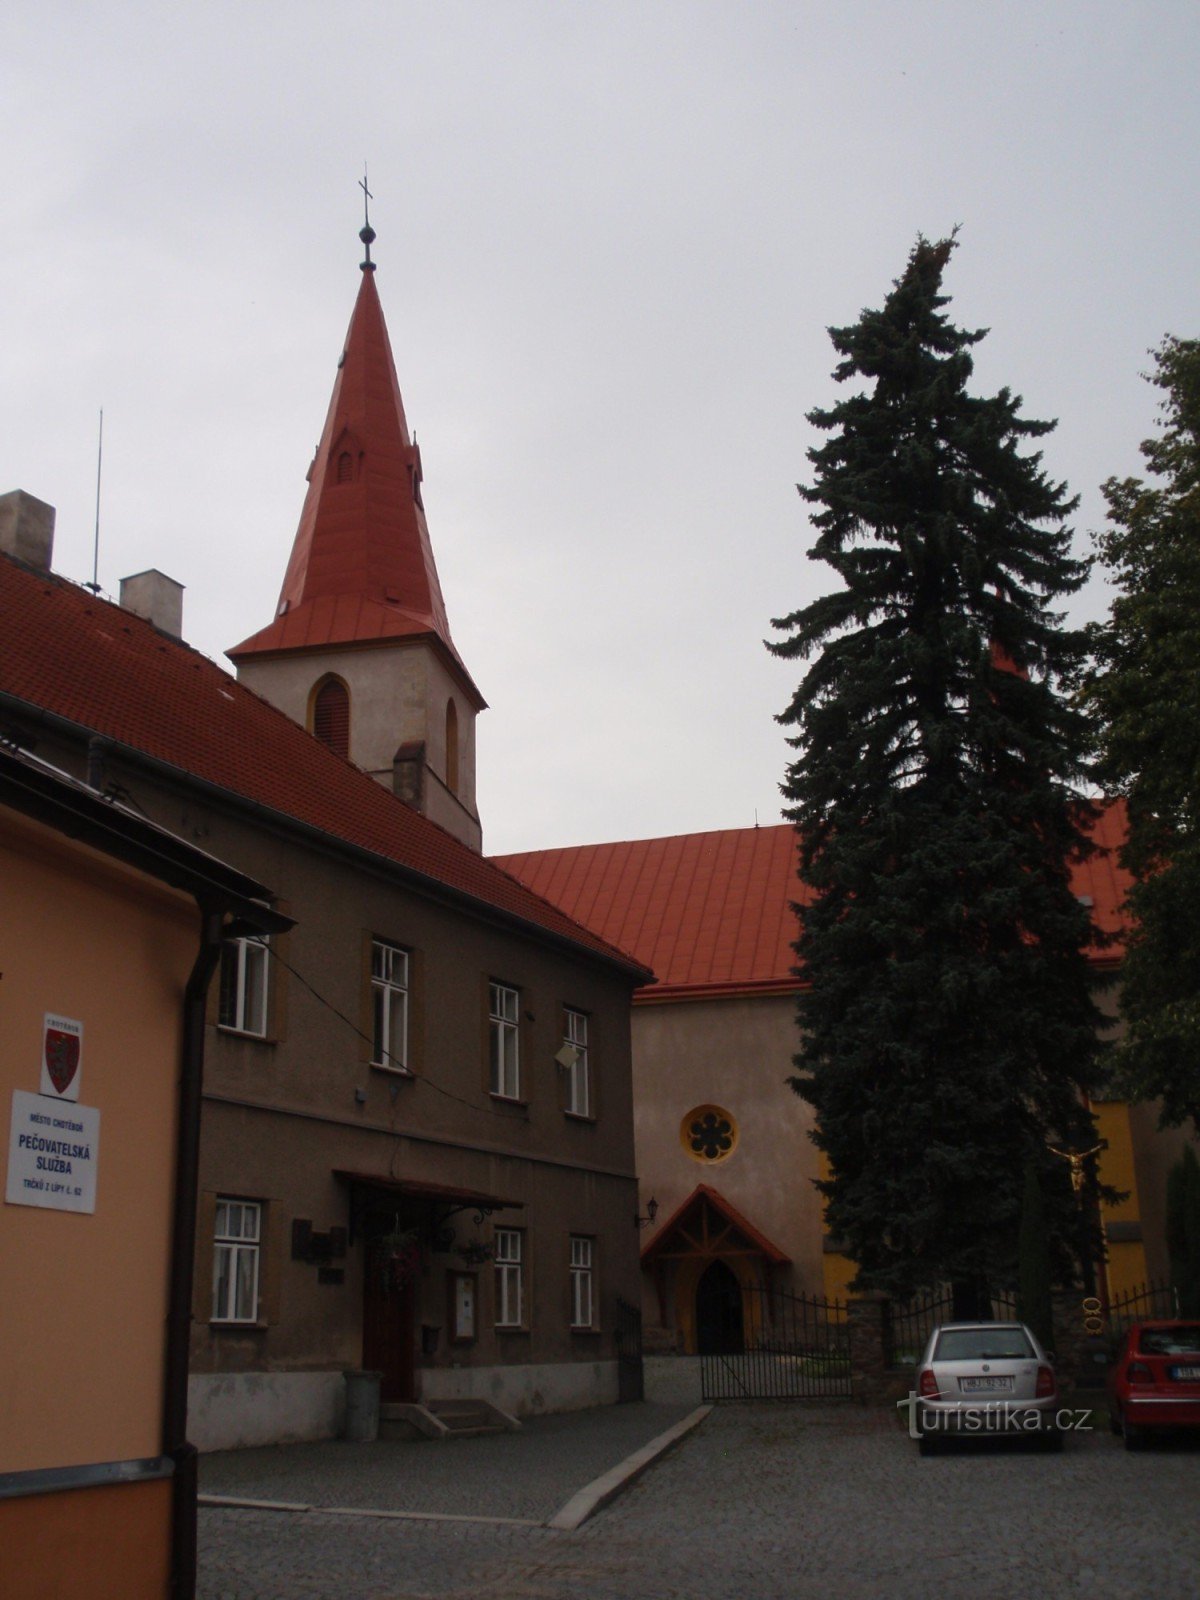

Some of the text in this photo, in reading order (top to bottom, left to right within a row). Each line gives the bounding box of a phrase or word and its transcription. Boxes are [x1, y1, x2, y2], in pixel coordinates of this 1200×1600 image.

[30, 1112, 84, 1132] MĚSTO CHOTĚBOŘ
[19, 1133, 90, 1159] PEČOVATELSKÁ
[36, 1155, 72, 1175] SLUŽBA
